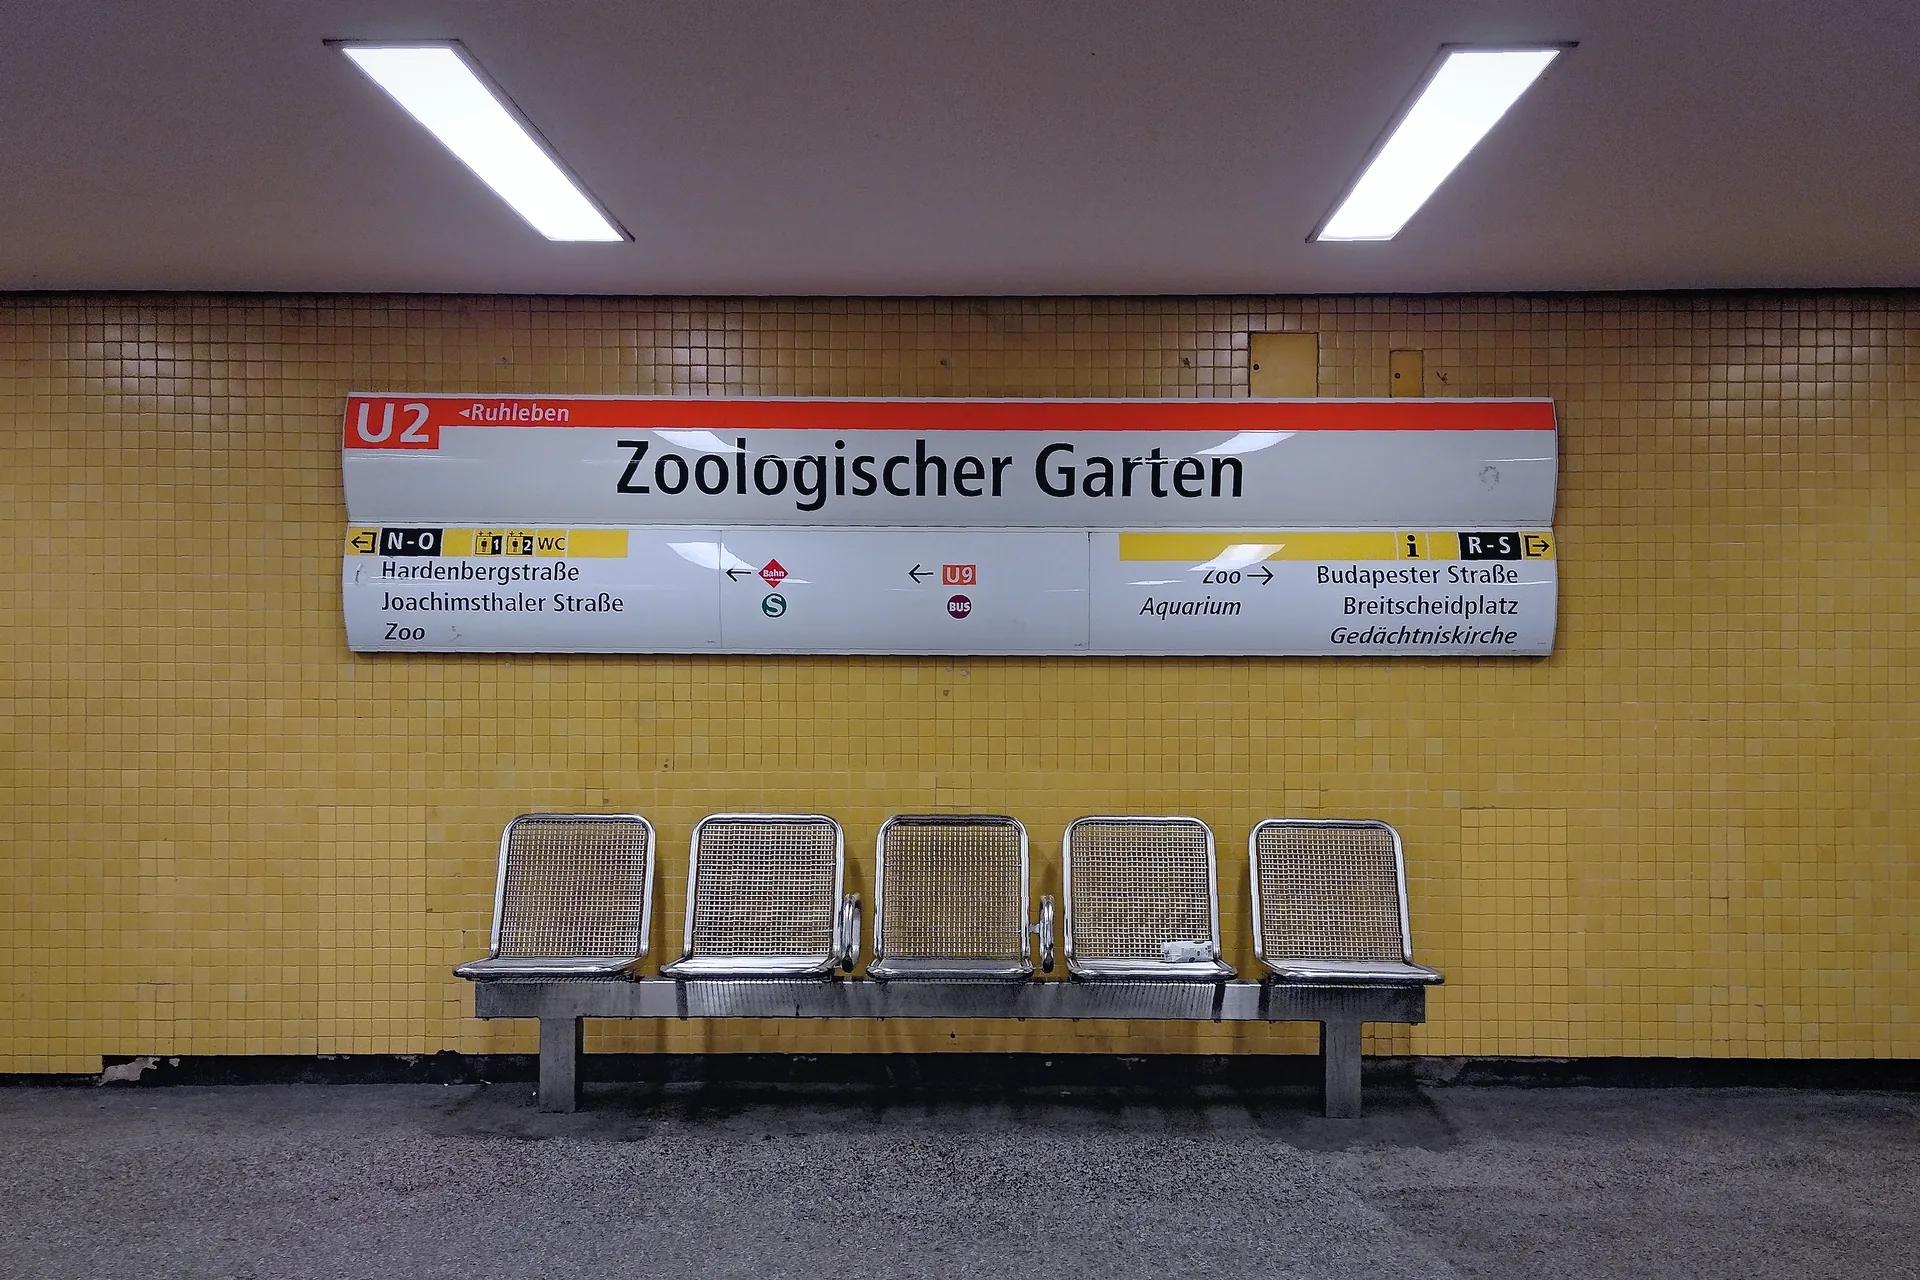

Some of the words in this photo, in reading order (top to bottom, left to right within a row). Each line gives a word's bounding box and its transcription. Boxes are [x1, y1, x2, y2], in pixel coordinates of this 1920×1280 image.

[471, 403, 570, 422] Ruhleben
[357, 402, 430, 443] U2
[616, 437, 1013, 511] Zoologischer
[1035, 443, 1243, 498] Garten
[492, 539, 500, 551] 1
[523, 540, 532, 552] 2
[537, 537, 566, 551] WC
[381, 561, 580, 585] Hardenbergstraße
[762, 569, 784, 578] Bahn
[946, 566, 974, 584] U9
[1202, 565, 1241, 584] Zoo
[1317, 565, 1441, 588] Budapester
[1448, 564, 1518, 584] Straße
[381, 592, 546, 613] Joachimsthaler
[553, 592, 625, 613] Straße
[765, 595, 783, 616] S
[949, 601, 971, 612] BUS
[1138, 595, 1242, 621] Aquarium
[1343, 595, 1519, 619] Breitscheidplatz
[384, 622, 426, 641] Zoo
[1330, 625, 1518, 645] Gedächtniskirche
